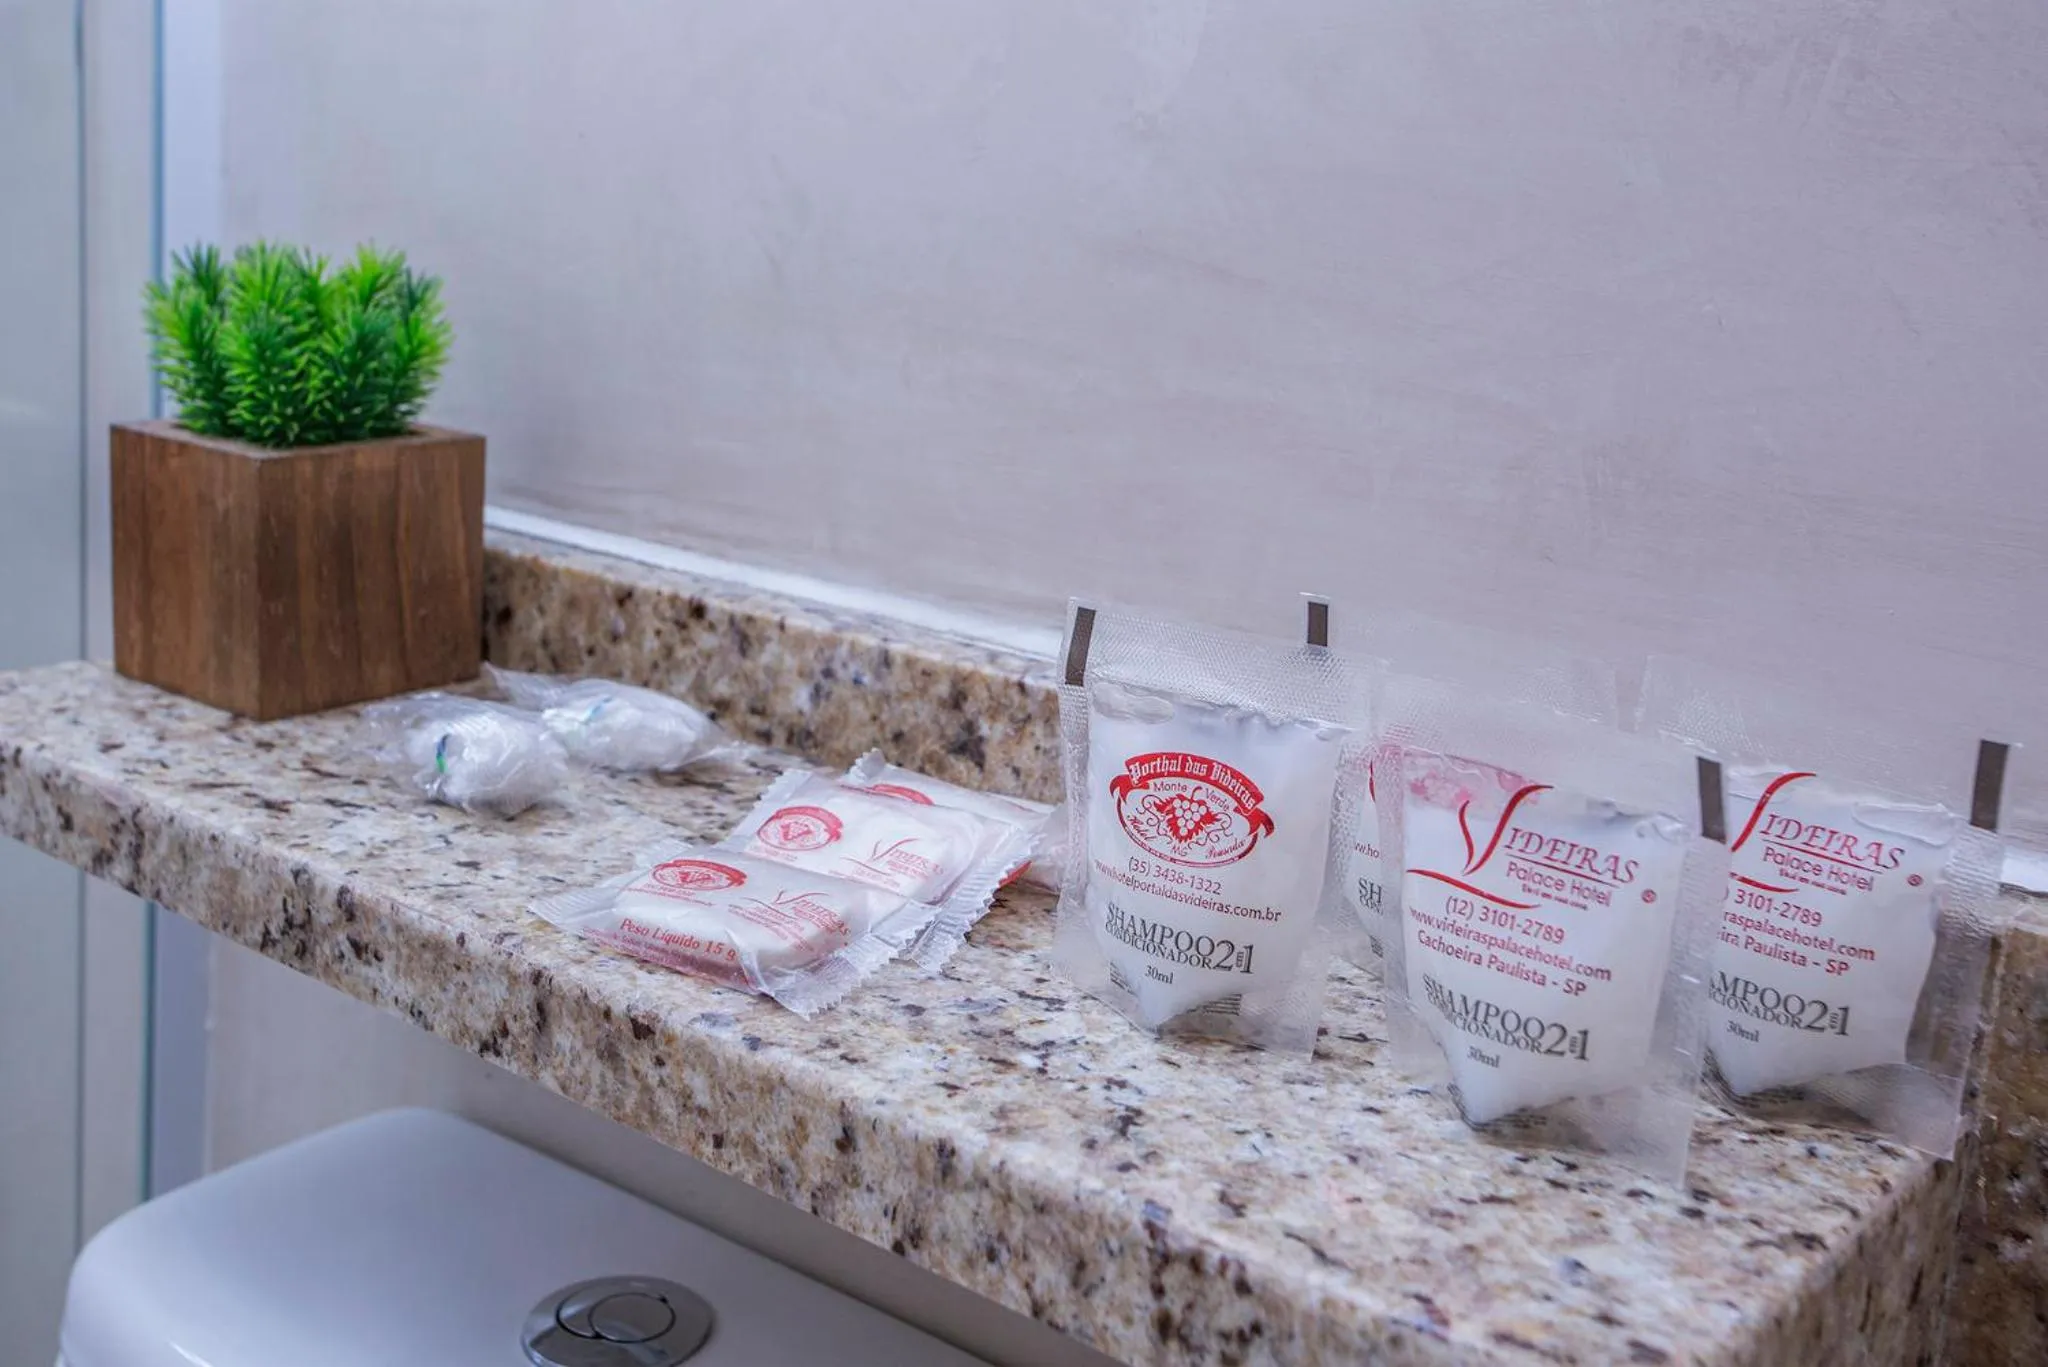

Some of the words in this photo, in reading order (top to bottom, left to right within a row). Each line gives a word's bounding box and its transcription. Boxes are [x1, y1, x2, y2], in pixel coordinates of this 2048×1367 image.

[1129, 755, 1182, 785] Porthal
[1185, 756, 1208, 776] das
[1210, 762, 1256, 810] Videiras
[1153, 781, 1187, 792] Monte
[1205, 788, 1230, 811] Verde
[1129, 857, 1151, 877] (35)
[1154, 865, 1222, 895] 3438-1322
[1506, 861, 1567, 892] Palace
[1571, 879, 1612, 907] Hotel
[1763, 847, 1823, 876] Palace
[1828, 865, 1875, 891] Hotel
[1106, 901, 1215, 957] SHAMPOO
[1445, 896, 1474, 922] (12)
[1479, 906, 1565, 944] 3101-2789
[1734, 888, 1822, 927] 3101-2789
[620, 918, 648, 935] Peso
[652, 927, 700, 949] Líquido
[705, 940, 725, 953] 15
[726, 949, 736, 961] g
[1723, 911, 1875, 960] raspalacehotel.com
[1744, 935, 1807, 967] Paulista
[1825, 959, 1849, 976] SP
[1145, 965, 1174, 984] 30ml
[1418, 929, 1483, 966] Cachoeira
[1487, 953, 1547, 987] Paulista
[1562, 978, 1587, 997] SP
[1727, 1020, 1760, 1042] 30ml
